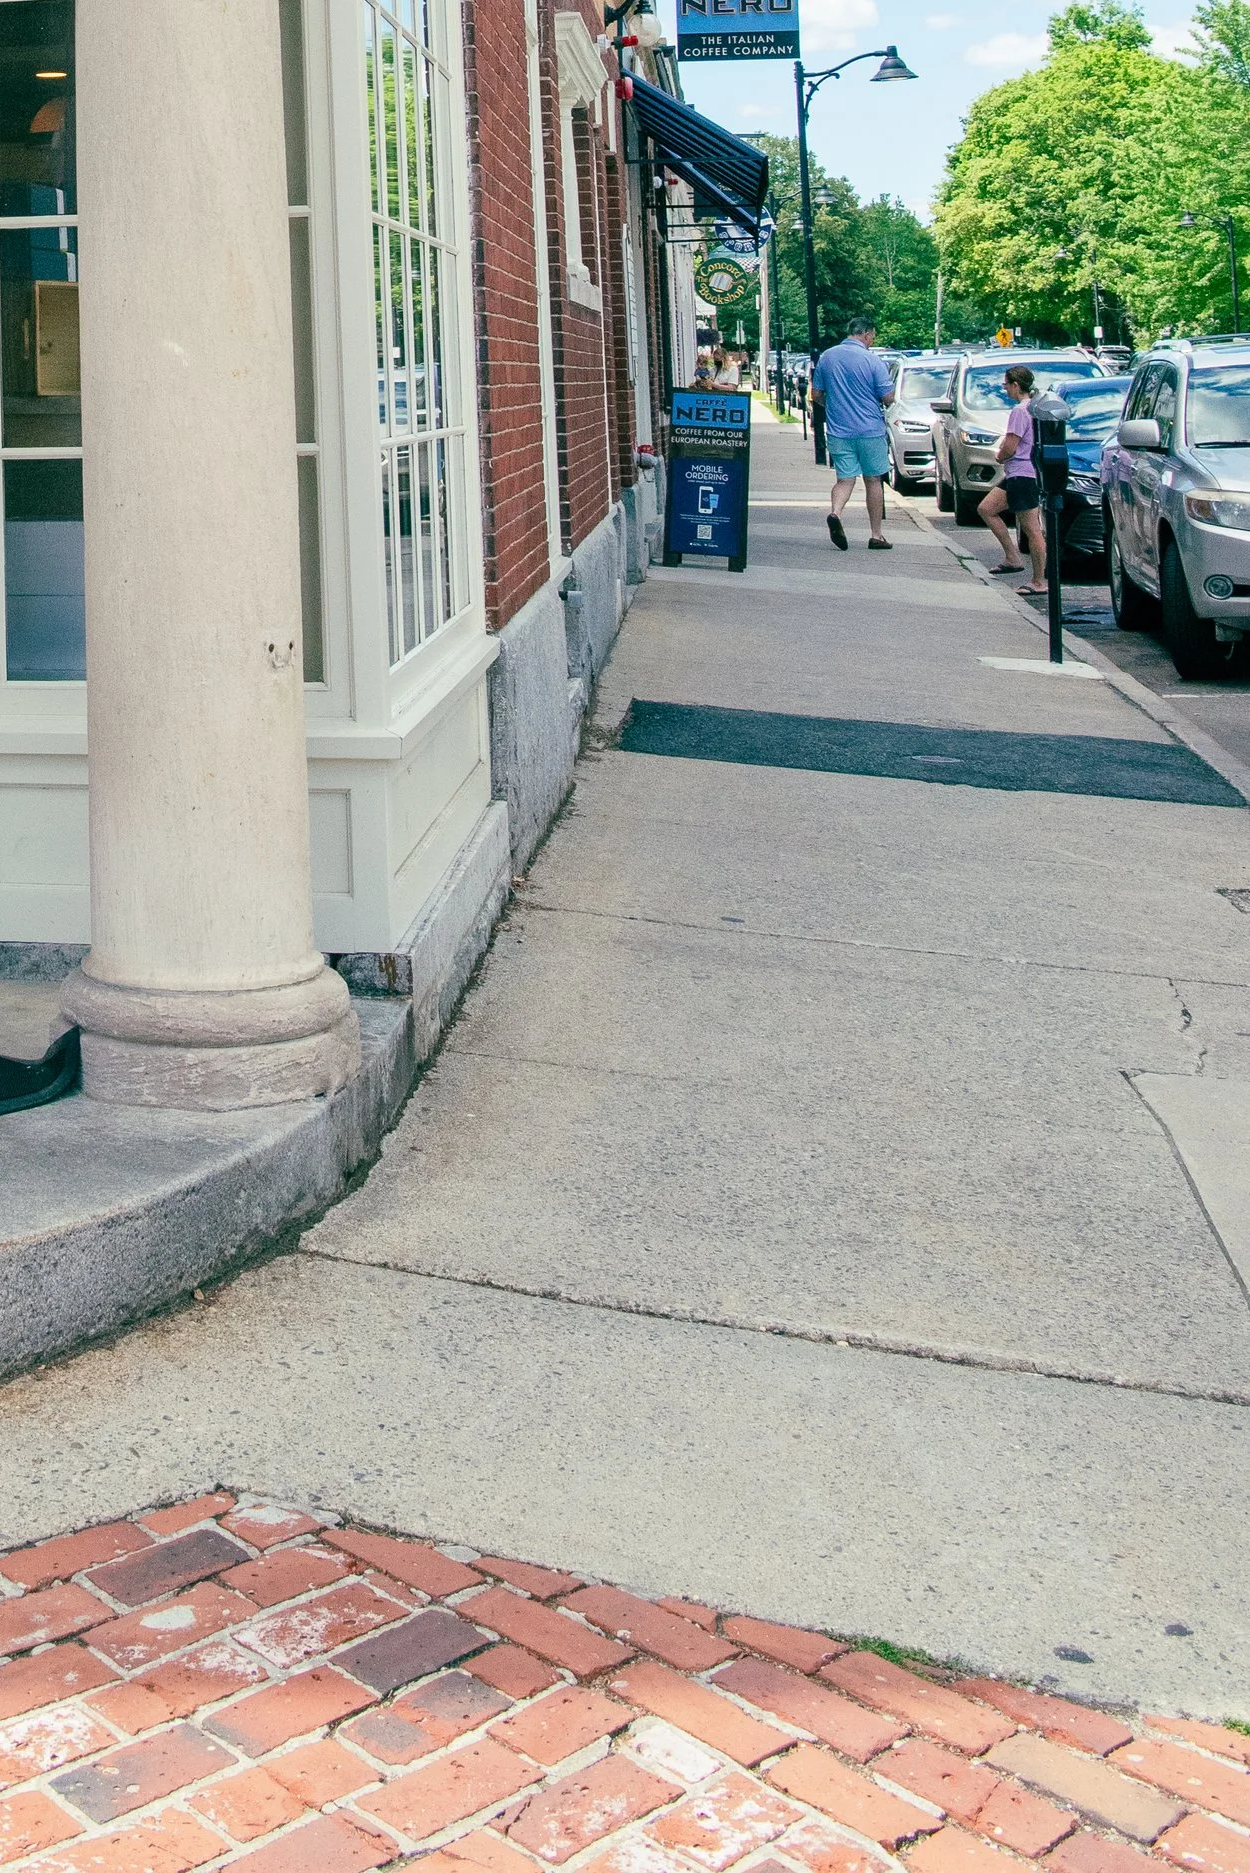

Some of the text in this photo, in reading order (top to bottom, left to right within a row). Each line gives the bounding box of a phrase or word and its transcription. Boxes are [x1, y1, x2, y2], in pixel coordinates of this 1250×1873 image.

[701, 34, 775, 45] THE ITALIAN
[684, 45, 793, 57] COFFEE COMPANY
[700, 262, 744, 278] Concord
[699, 283, 745, 304] Bookshop
[676, 407, 745, 424] NERO
[675, 428, 702, 436] COFFEE
[704, 429, 725, 437] FROM
[671, 436, 748, 448] EUROPEAN ROASTERY
[691, 464, 723, 473] MOBILE
[685, 472, 729, 482] ORDERING
